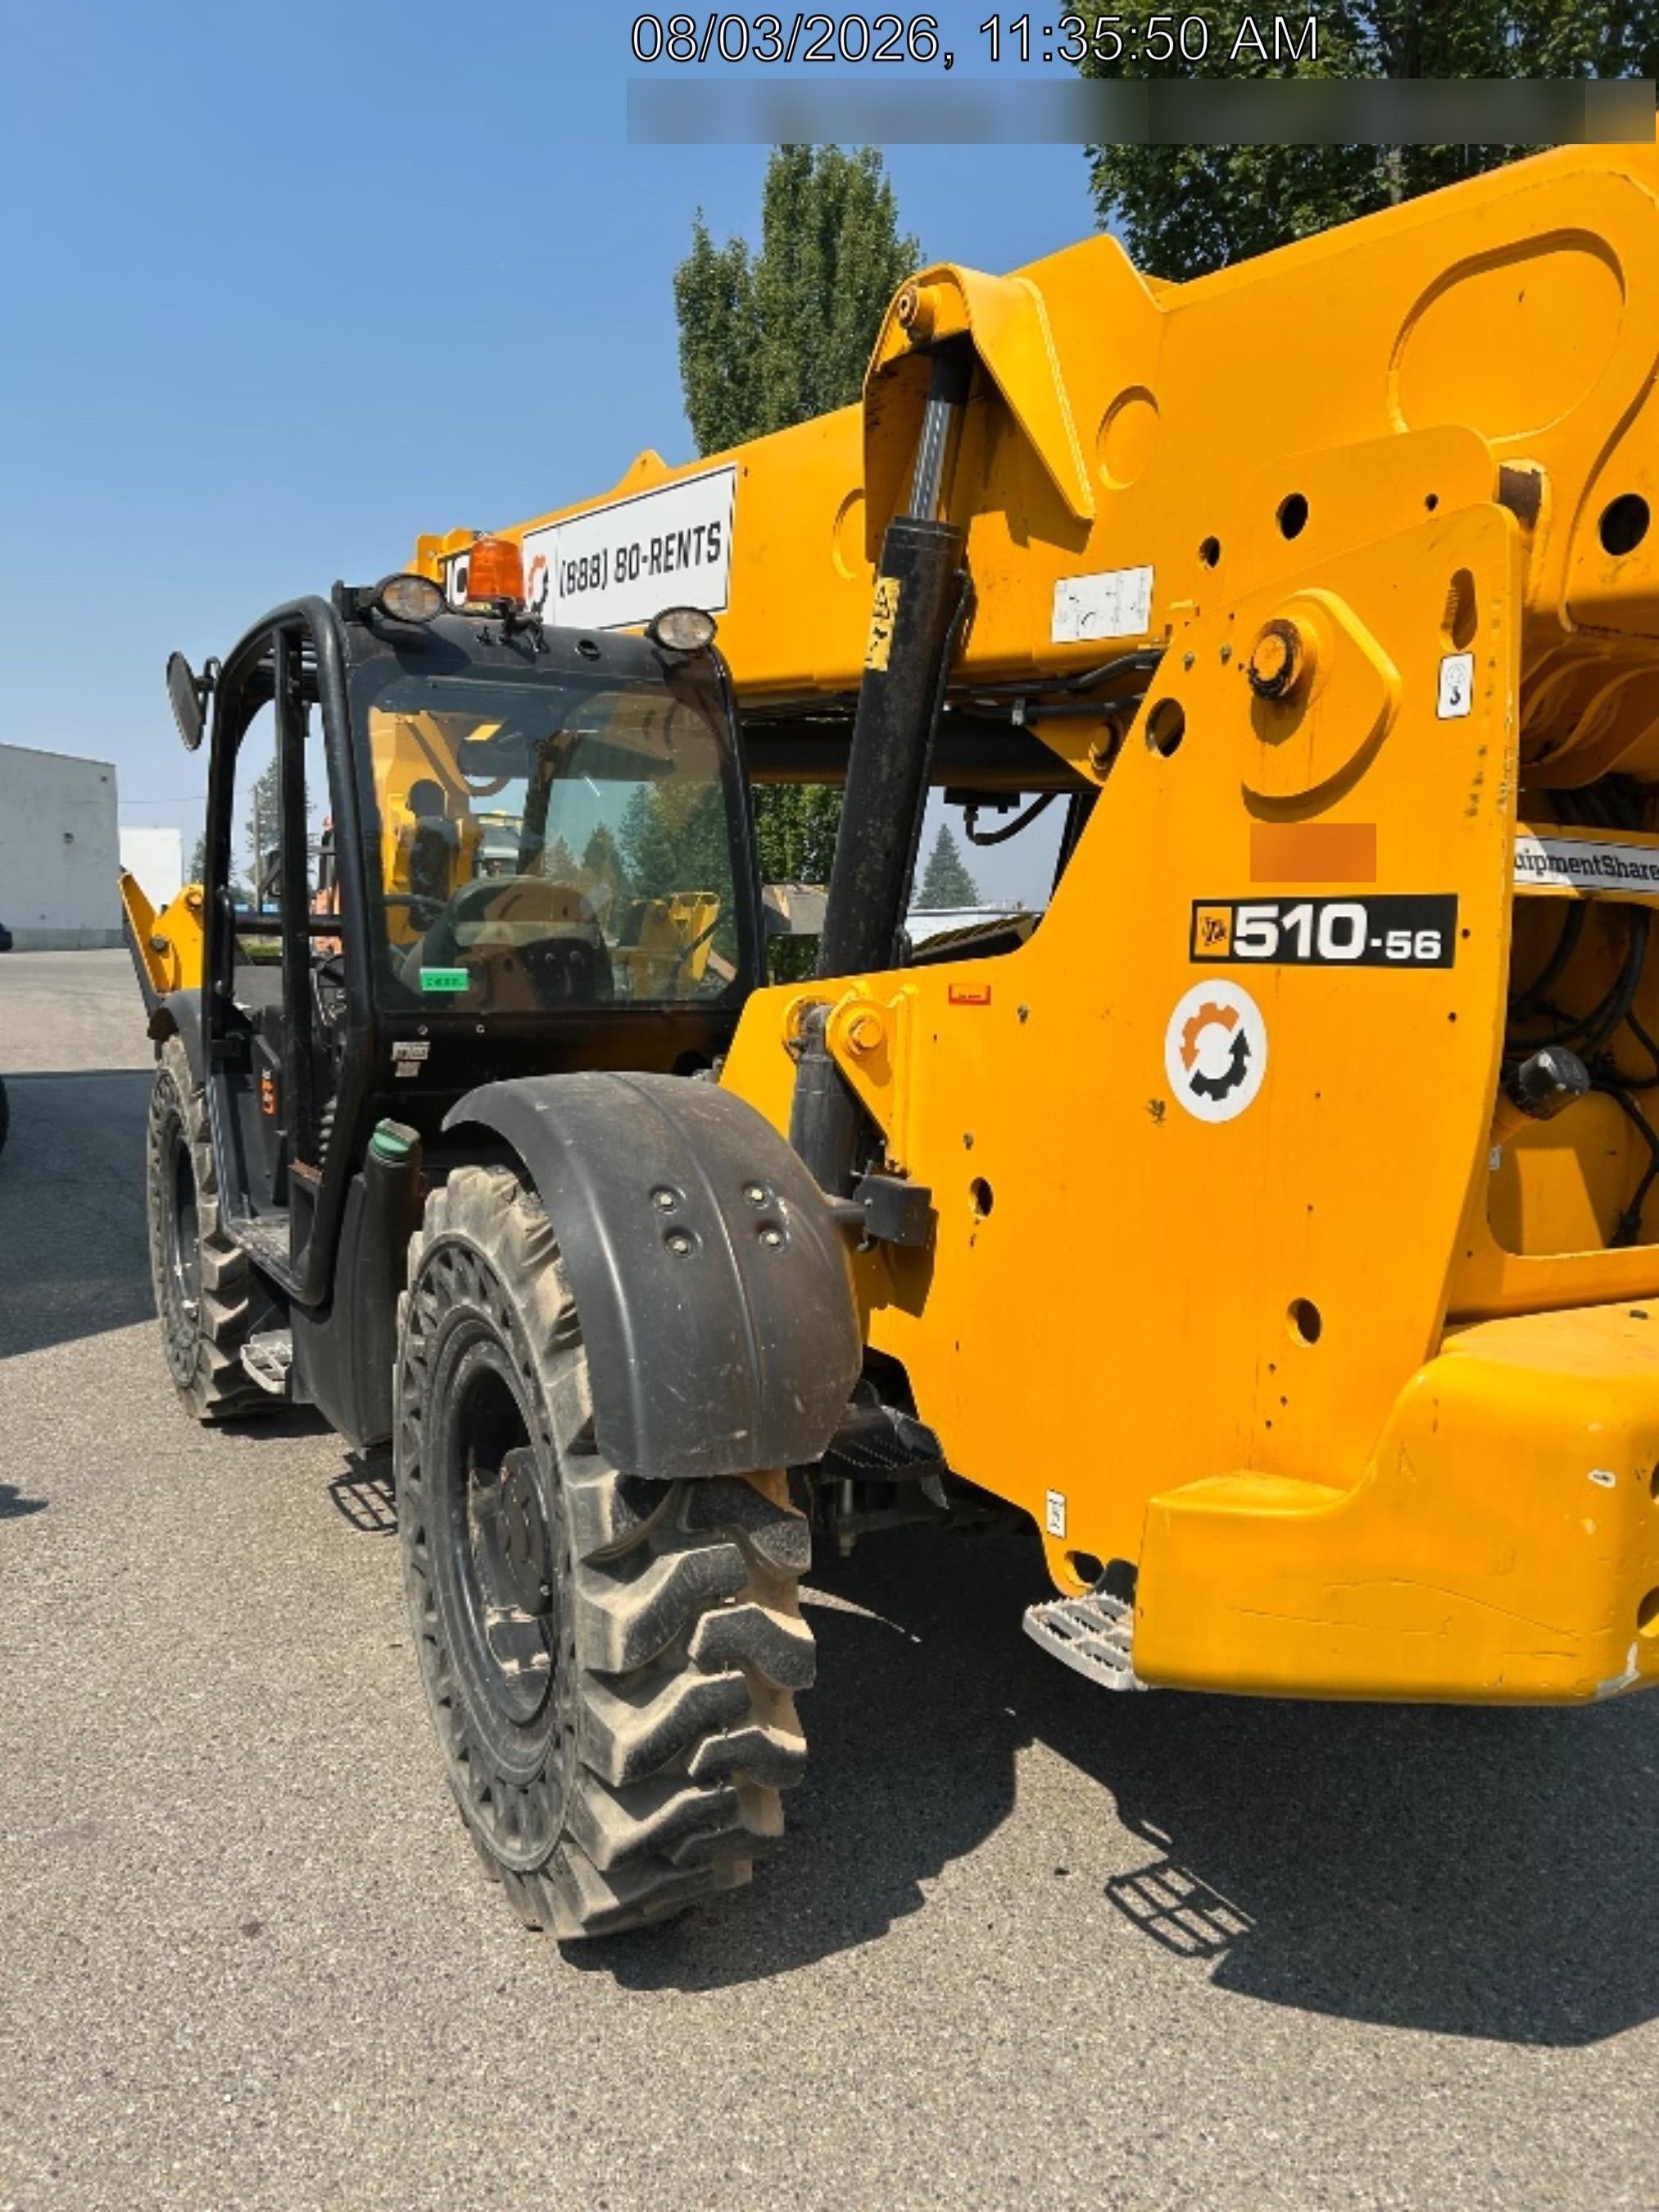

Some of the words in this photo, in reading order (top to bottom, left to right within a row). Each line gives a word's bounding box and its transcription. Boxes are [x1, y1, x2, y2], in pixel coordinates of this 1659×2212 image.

[560, 548, 608, 598] (888)
[614, 520, 721, 583] 80-RENTS
[1233, 903, 1442, 959] 510-56
